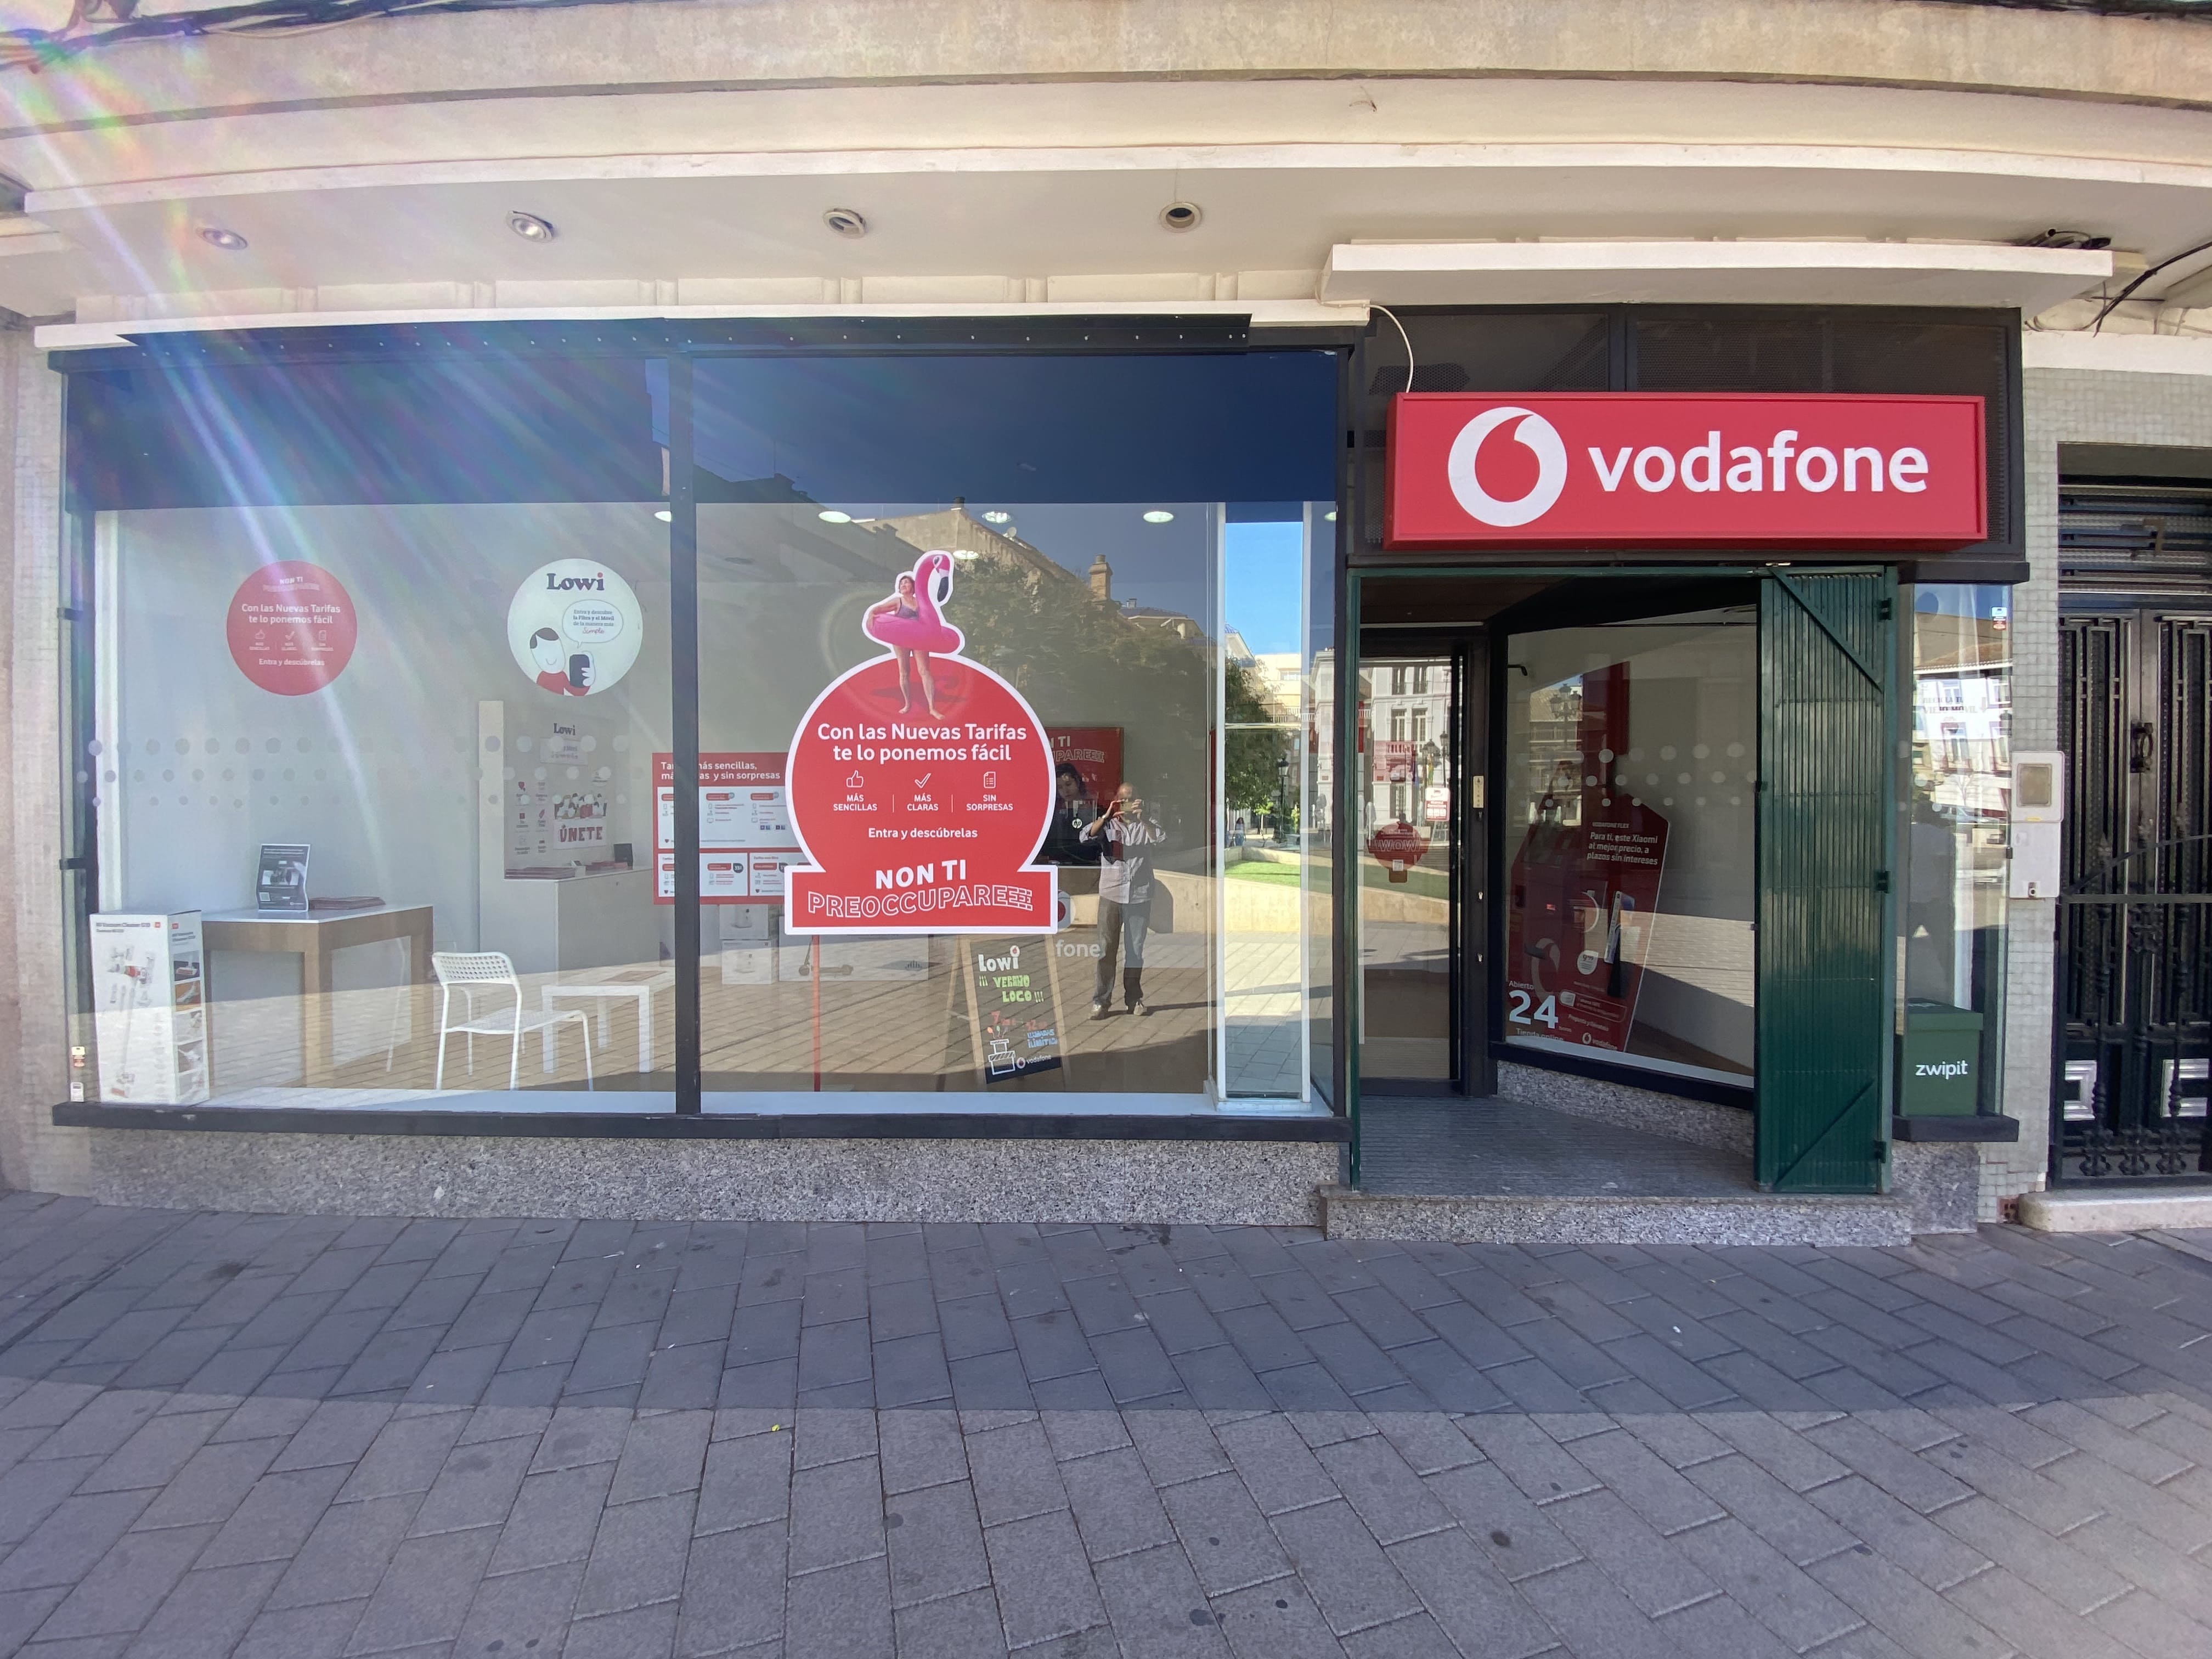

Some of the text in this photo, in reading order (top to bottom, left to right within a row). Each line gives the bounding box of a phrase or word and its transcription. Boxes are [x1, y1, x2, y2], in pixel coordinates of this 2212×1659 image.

[1588, 430, 1929, 493] vodafone
[546, 572, 605, 591] Lowi
[241, 603, 341, 613] Con las Nuevas Tarifas
[259, 614, 268, 623] lo
[270, 616, 312, 625] ponemos
[314, 614, 333, 624] fácil
[554, 723, 575, 736] Lowi
[817, 723, 1027, 740] Con las Nuevas Tarifas
[1058, 735, 1070, 747] TI
[833, 743, 1012, 765] te lo ponemos fácil
[714, 761, 757, 770] sencillas,
[714, 773, 719, 781] y
[847, 793, 864, 802] MÁS
[914, 793, 932, 802] MÁS
[833, 803, 877, 811] SENCILLAS
[907, 803, 939, 811] CLARAS
[1073, 819, 1082, 829] hp
[559, 824, 603, 843] ÚNETE
[868, 827, 978, 840] Entra y descúbrelas
[1590, 832, 1605, 840] Para
[1632, 834, 1658, 843] Xiaomi
[1596, 843, 1617, 852] mejor
[1618, 845, 1643, 854] precio,
[1587, 852, 1658, 865] plazos sin intereses
[876, 859, 966, 889] NON TI
[1056, 939, 1101, 957] fone
[978, 945, 1020, 972] Lowi
[1509, 980, 1534, 990] Abierto
[1002, 990, 1032, 1003] LOCO
[1509, 990, 1559, 1029] 24
[1026, 1054, 1052, 1064] vodafone
[1915, 1060, 1968, 1080] zwipit
